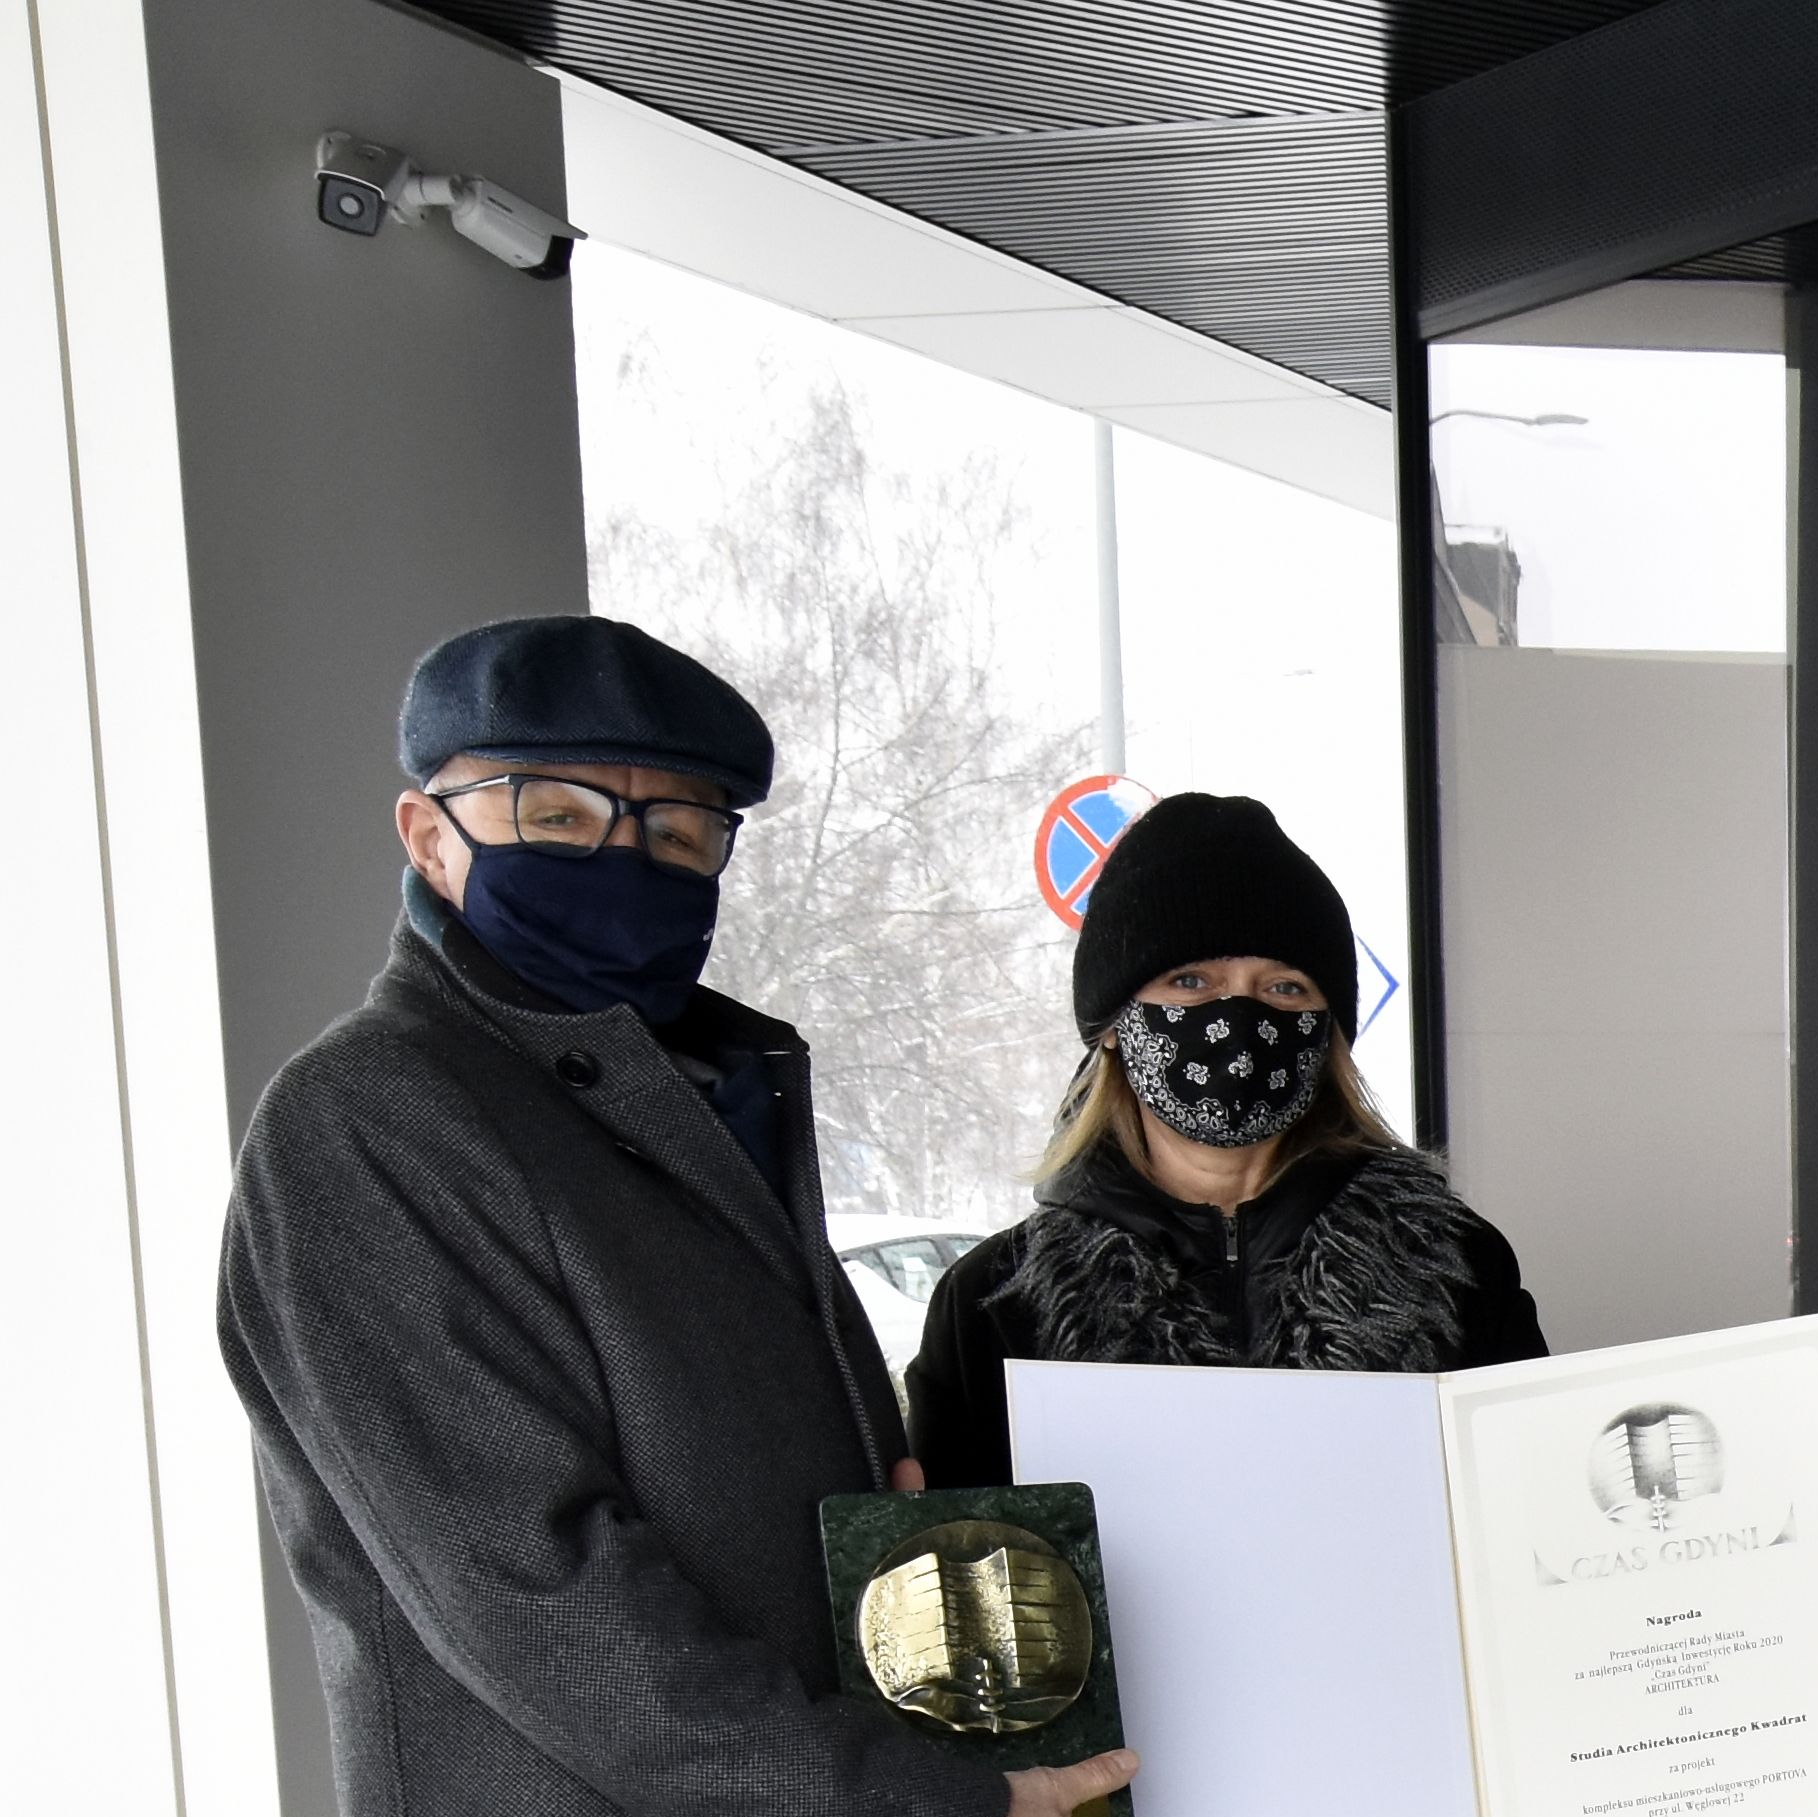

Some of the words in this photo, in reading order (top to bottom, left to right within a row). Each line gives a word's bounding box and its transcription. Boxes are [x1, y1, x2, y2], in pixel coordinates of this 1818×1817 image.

[1571, 1546, 1648, 1580] CZAS
[1659, 1526, 1761, 1565] GDYNI
[1645, 1609, 1703, 1626] Nagroda
[1574, 1671, 1585, 1680] za
[1588, 1662, 1633, 1679] najlepszą
[1733, 1641, 1757, 1653] Roku
[1760, 1635, 1784, 1648] 2020
[1609, 1638, 1688, 1661] Przewodniczącej
[1689, 1635, 1712, 1648] Rady
[1714, 1629, 1745, 1641] Miasta
[1645, 1674, 1720, 1695] ARCHITEKTURA
[1678, 1705, 1693, 1716] dla
[1569, 1745, 1613, 1762] Studia
[1616, 1722, 1747, 1755] Architektonicznego
[1750, 1713, 1808, 1731] Kwadrat
[1669, 1763, 1679, 1774] za
[1681, 1757, 1716, 1774] projekt
[1582, 1798, 1634, 1815] kompleksu
[1762, 1768, 1807, 1785] PORTOVA
[1671, 1802, 1684, 1815] ul.
[1733, 1792, 1745, 1803] 22
